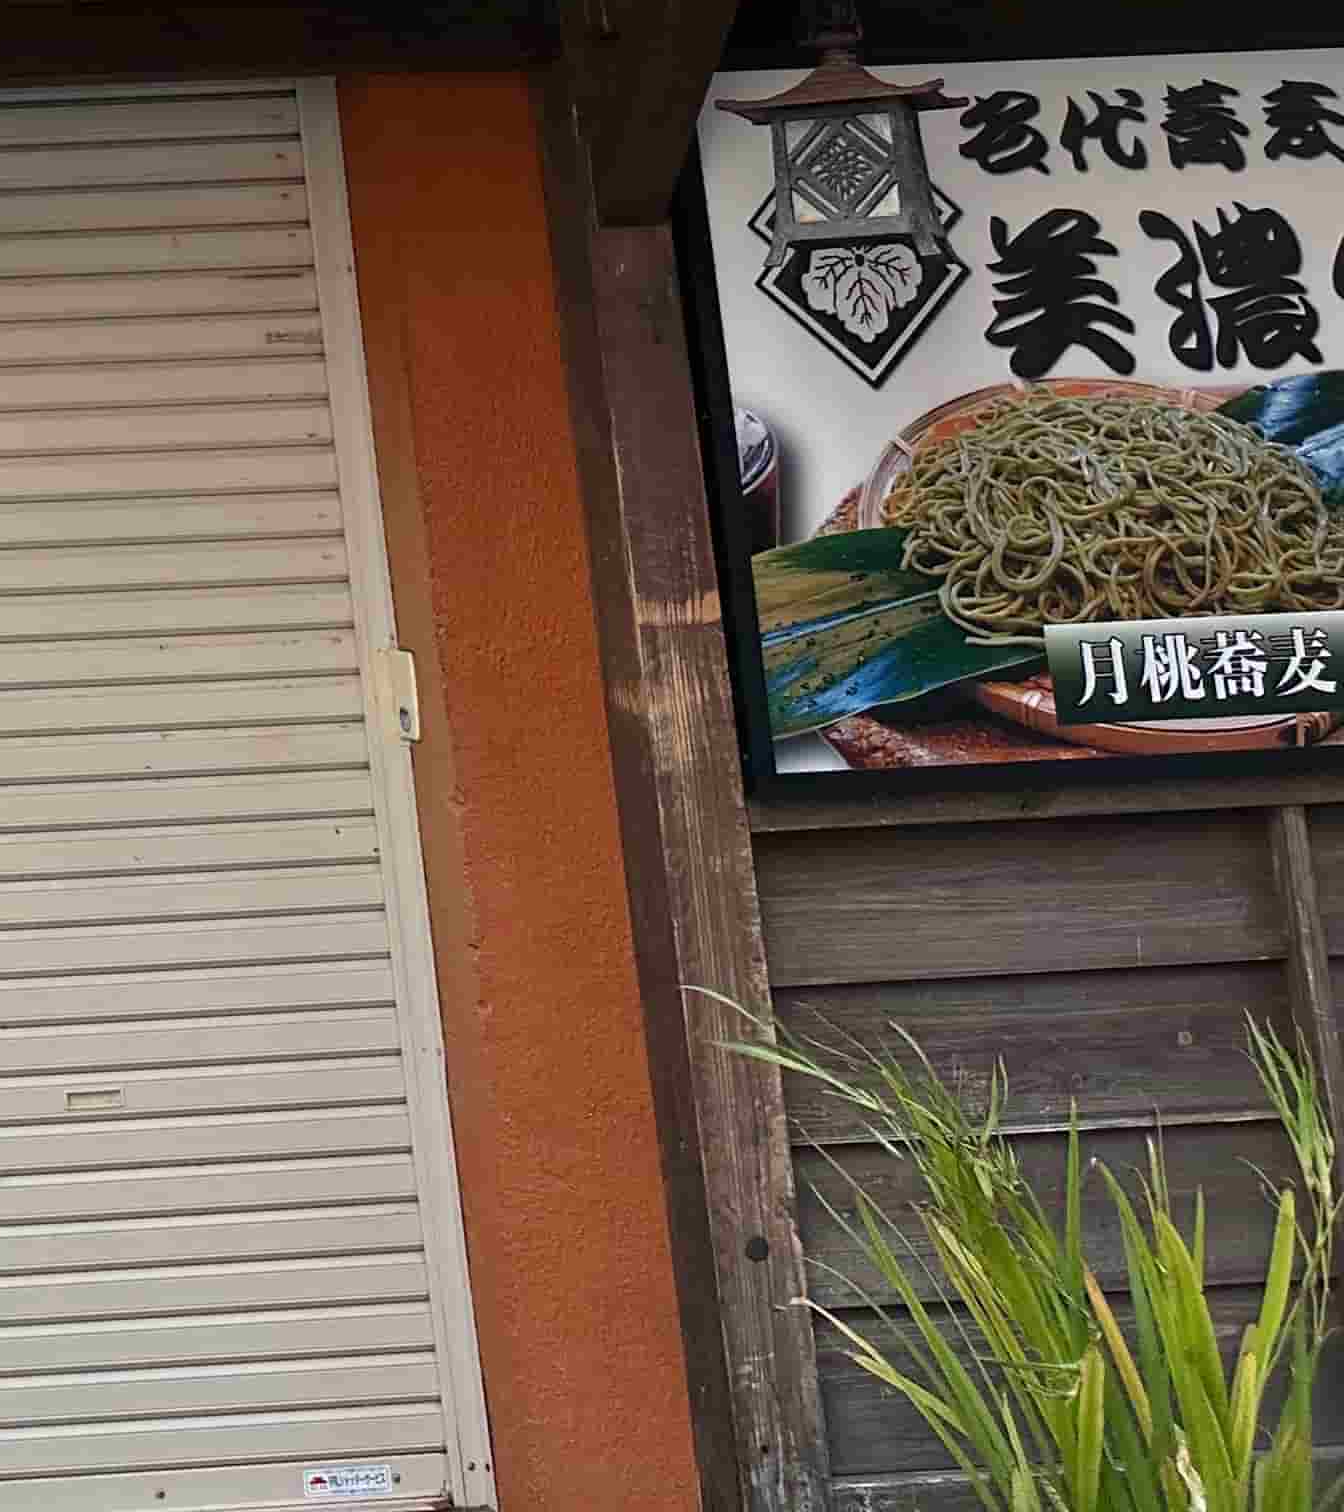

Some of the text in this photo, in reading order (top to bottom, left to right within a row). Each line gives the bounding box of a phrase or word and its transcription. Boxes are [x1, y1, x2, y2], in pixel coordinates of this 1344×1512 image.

[984, 200, 1344, 379] 美濃
[1076, 625, 1338, 708] 月桃蕎麦
